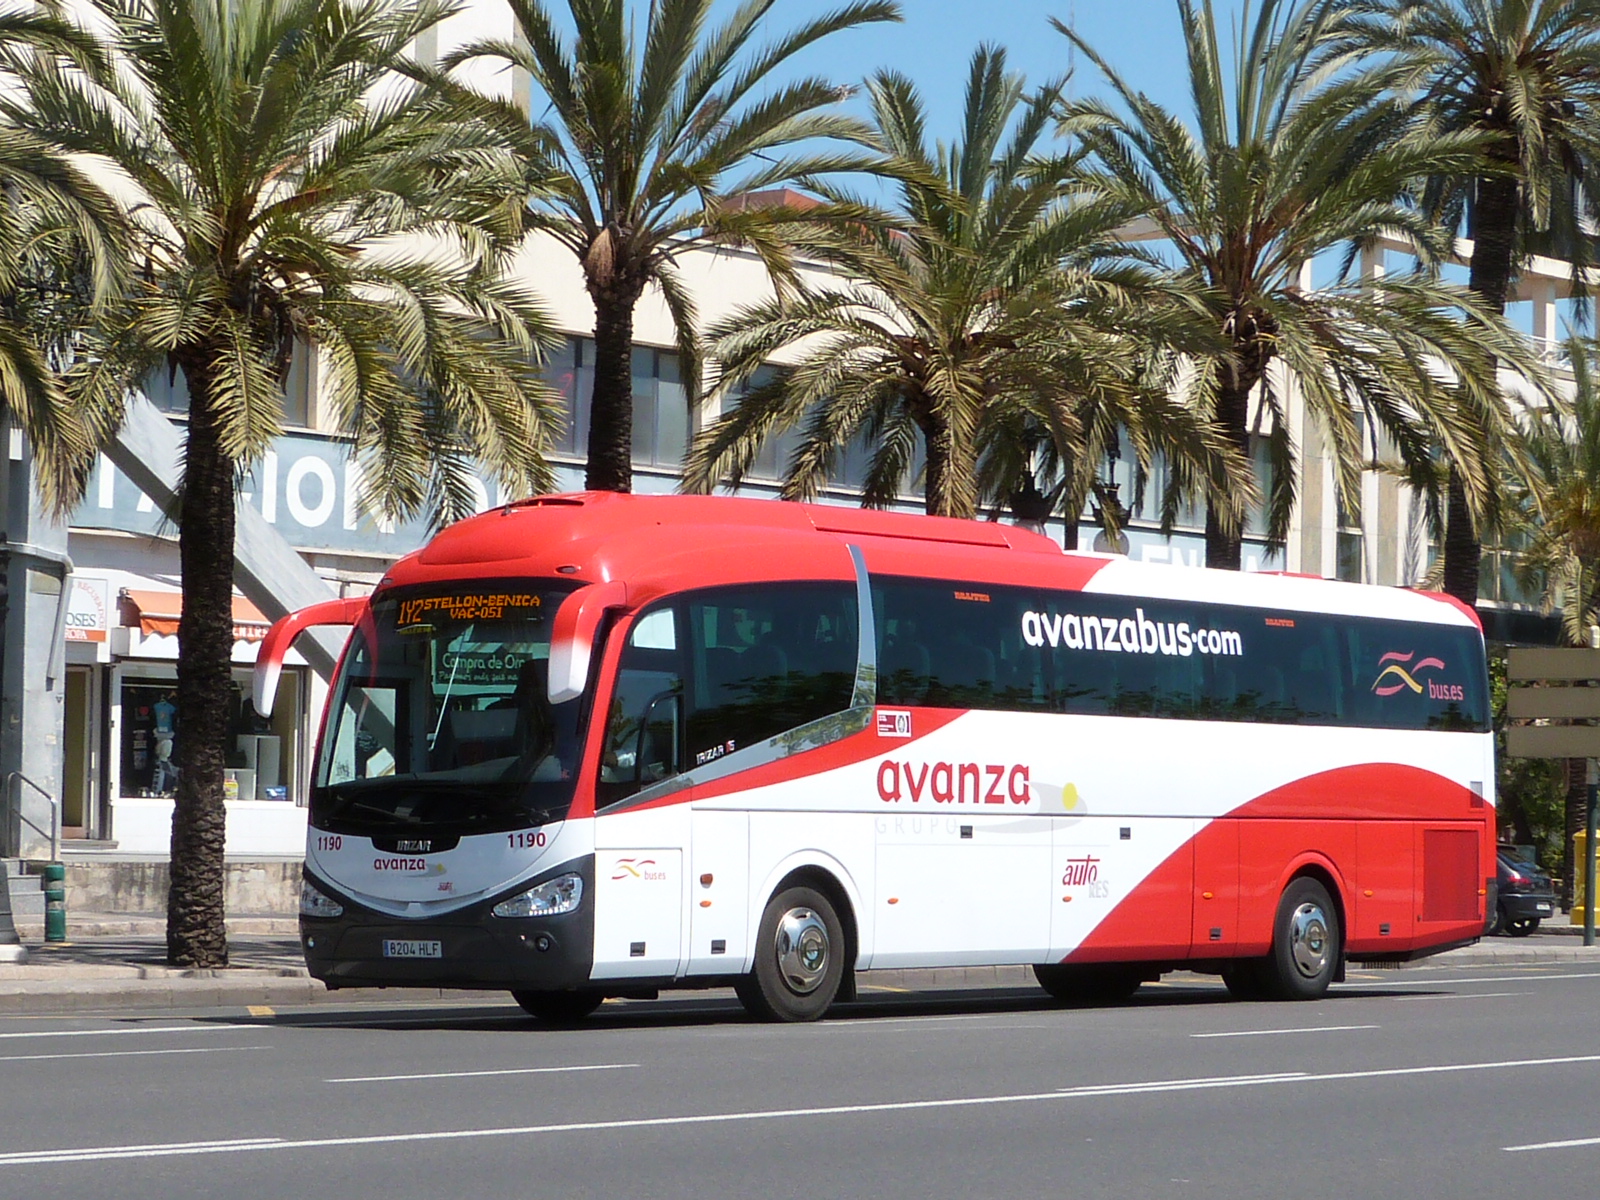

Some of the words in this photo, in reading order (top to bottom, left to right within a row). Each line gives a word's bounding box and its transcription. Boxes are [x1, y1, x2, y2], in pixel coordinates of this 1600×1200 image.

[423, 594, 541, 610] STELLON-BENICA
[450, 606, 503, 619] VAC-051
[488, 654, 503, 669] de
[1428, 678, 1464, 700] bus.es
[696, 744, 725, 765] IRIZAR
[877, 759, 1031, 805] avanza
[875, 815, 958, 835] GRUPO
[317, 836, 342, 851] 1190
[396, 840, 432, 852] IRIZAR
[507, 832, 547, 849] 1190
[373, 858, 426, 871] avanza
[1062, 854, 1100, 886] auto
[389, 941, 416, 956] 8204
[418, 942, 440, 956] HLF
